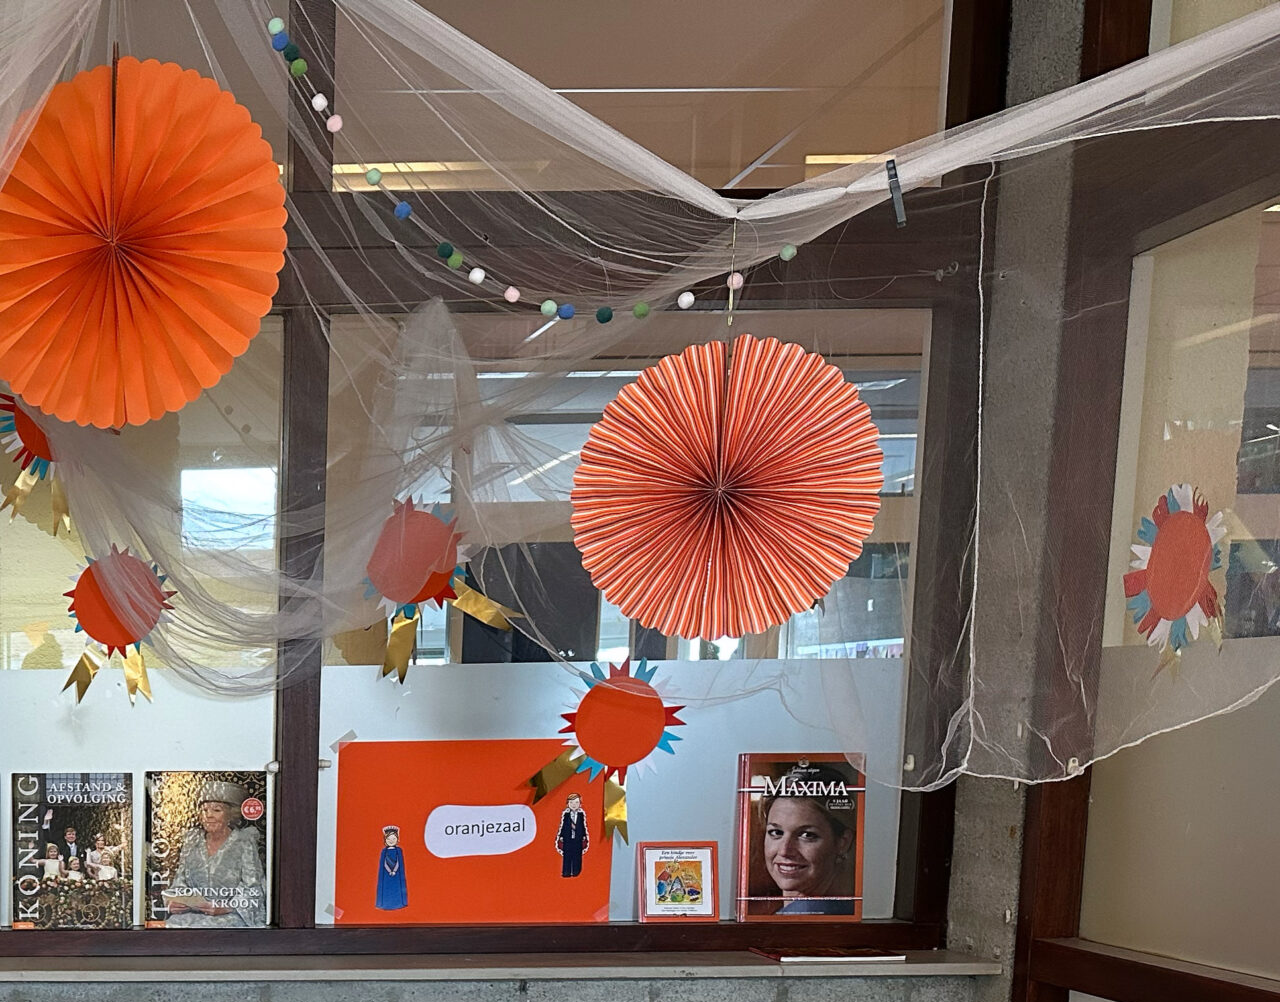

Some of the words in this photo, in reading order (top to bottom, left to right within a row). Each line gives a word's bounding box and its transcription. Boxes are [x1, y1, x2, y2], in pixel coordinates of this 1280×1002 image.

[49, 782, 111, 792] AFSTAND
[116, 782, 126, 792] &
[763, 776, 848, 796] MÁXIMA
[47, 794, 126, 804] OPVOLGING
[444, 817, 526, 837] oranjezaal
[18, 775, 40, 920] KONING
[175, 887, 244, 897] KONINGIN
[249, 887, 259, 897] &
[211, 899, 260, 908] KROON
